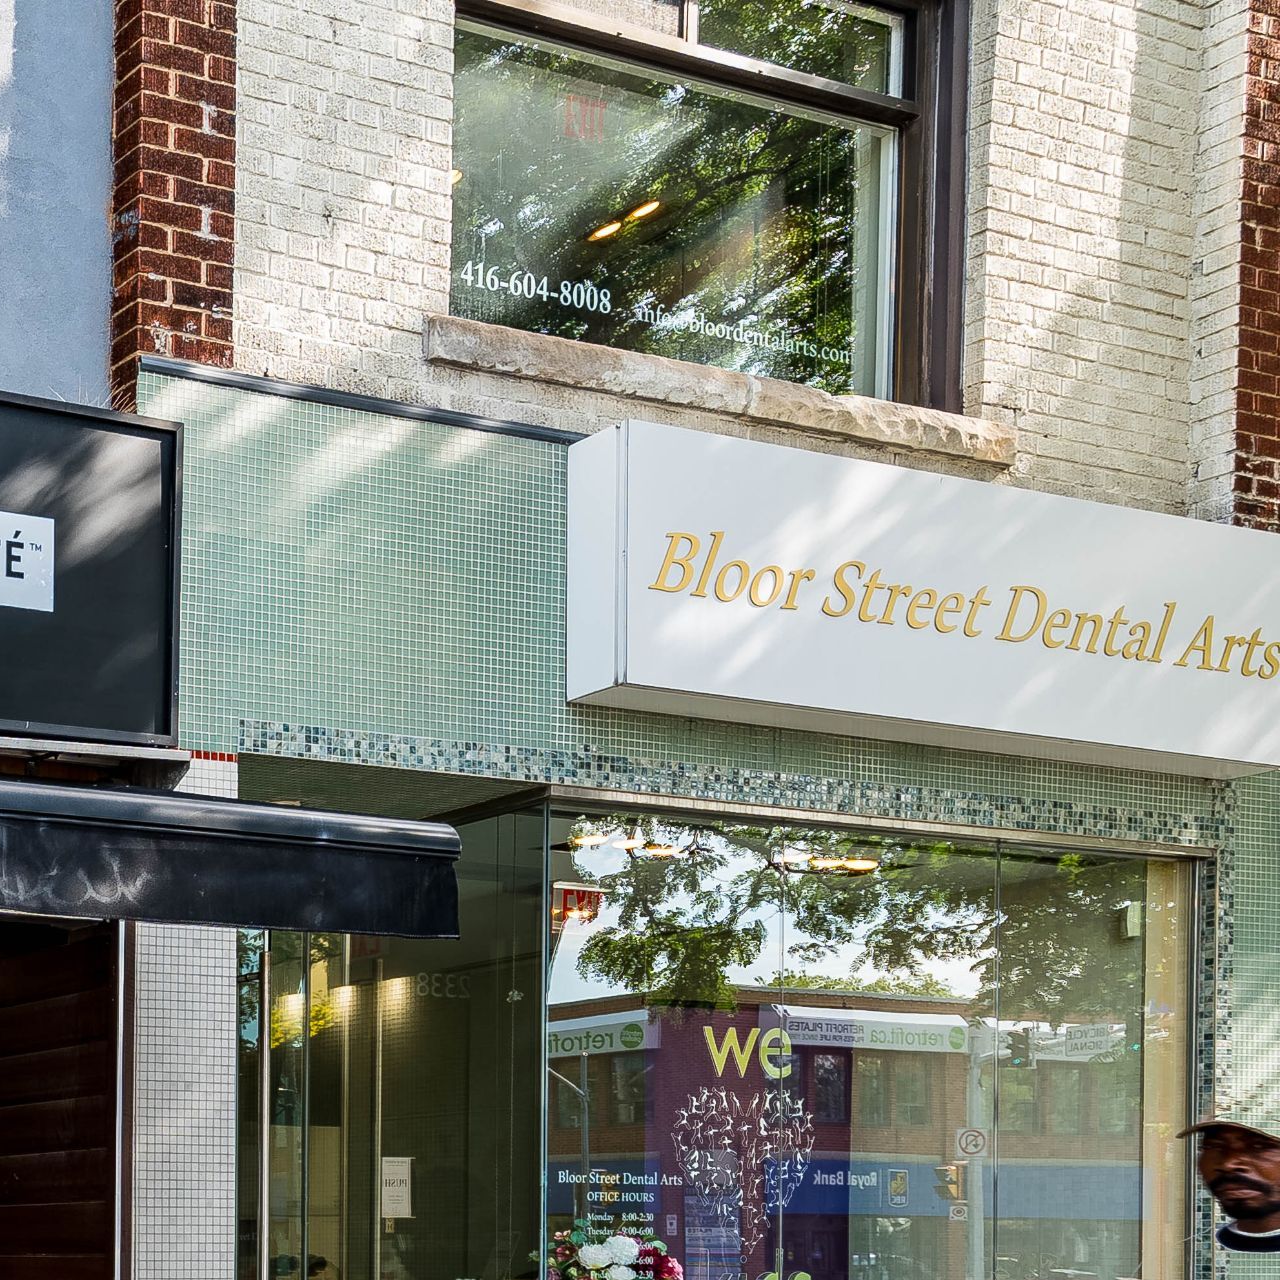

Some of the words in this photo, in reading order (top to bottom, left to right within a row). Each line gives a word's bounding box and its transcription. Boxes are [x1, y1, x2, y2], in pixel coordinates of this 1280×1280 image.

[460, 261, 612, 315] 416-604-8008
[648, 531, 816, 611] Bloor
[821, 560, 991, 638] Street
[995, 584, 1177, 664] Dental
[1173, 614, 1280, 681] Arts
[702, 1025, 793, 1080] we
[558, 1170, 587, 1184] Bloor
[589, 1171, 620, 1184] Street
[623, 1172, 658, 1185] Dental
[660, 1174, 683, 1186] Arts
[587, 1191, 619, 1202] OFFICE
[622, 1192, 654, 1203] HOURS
[587, 1212, 614, 1223] Monday
[622, 1212, 654, 1221] 8:00-2:30
[587, 1227, 614, 1237] Tuesday
